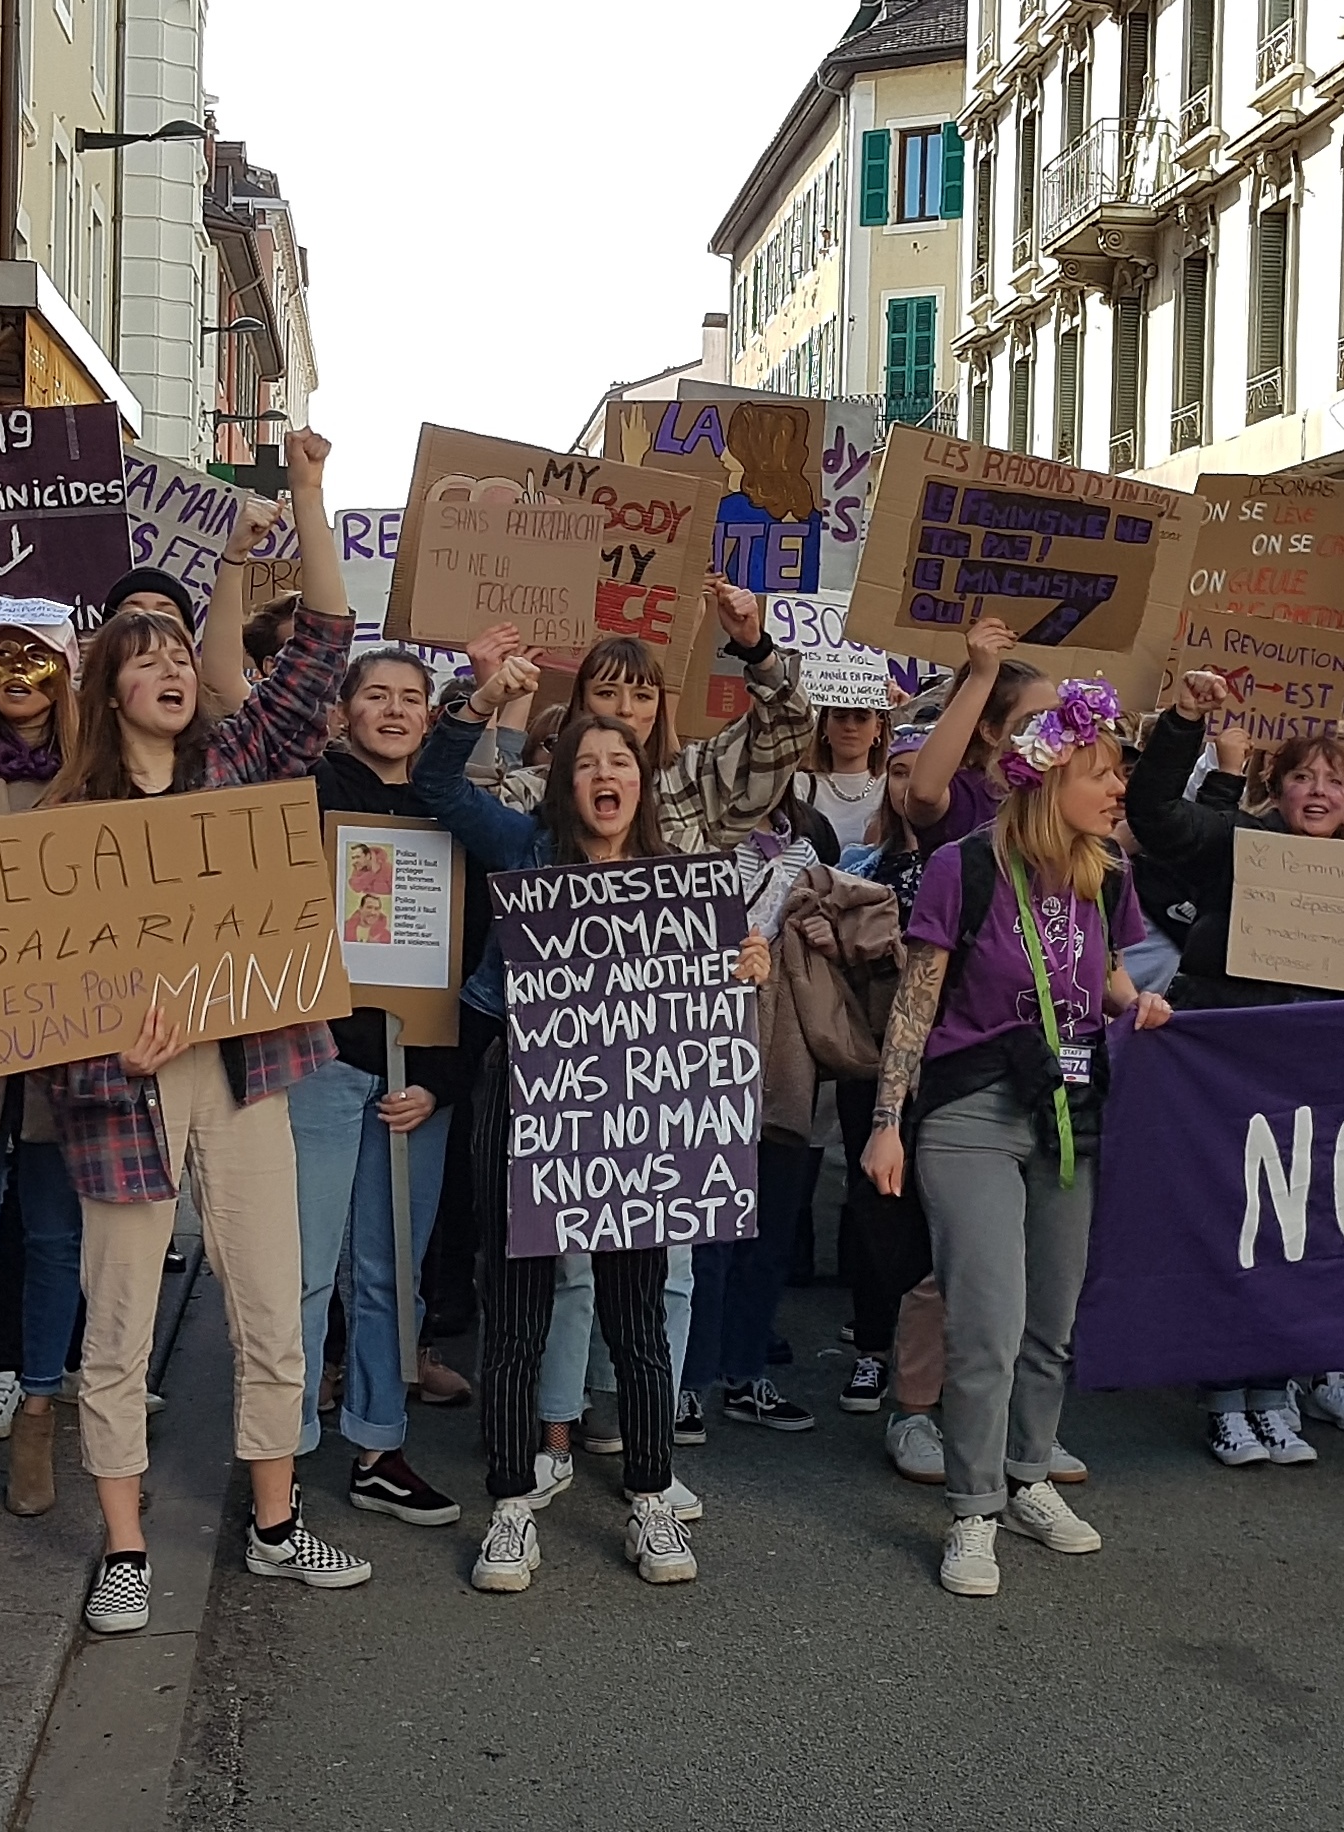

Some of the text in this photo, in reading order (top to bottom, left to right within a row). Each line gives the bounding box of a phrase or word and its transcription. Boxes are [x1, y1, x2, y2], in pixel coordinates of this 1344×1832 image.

[654, 401, 727, 457] LA
[924, 437, 971, 473] LES
[124, 455, 158, 511] TA
[542, 459, 601, 496] MY
[441, 506, 605, 544] SANS PATRIARCAT
[592, 487, 692, 543] BODY
[924, 484, 1151, 542] LE FEMINISME NE
[1237, 499, 1268, 522] SE
[1272, 500, 1317, 526] LÈVE
[427, 548, 512, 578] TU NE LA
[983, 535, 1031, 560] PAS
[1251, 533, 1283, 556] ON
[1288, 533, 1314, 553] SE
[475, 582, 570, 616] FORCERAIS
[914, 560, 1116, 600] LE MACHISME
[1189, 566, 1309, 597] ON GUEULE
[1187, 622, 1213, 649] LA
[848, 654, 876, 666] VIOL
[1284, 681, 1335, 709] EST
[492, 859, 740, 914] WHY DOES EVERY
[1243, 888, 1276, 903] sera
[521, 901, 718, 961] WOMAN
[1240, 917, 1253, 935] le
[80, 967, 148, 1002] POUR
[152, 928, 336, 1037] MANU
[506, 949, 754, 1005] KNOW ANOTHER
[509, 986, 756, 1052] WOMAN THAT
[514, 1036, 760, 1105] WAS RAPED
[514, 1085, 754, 1158] BUT NO MAN
[532, 1152, 737, 1206] KNOWS A
